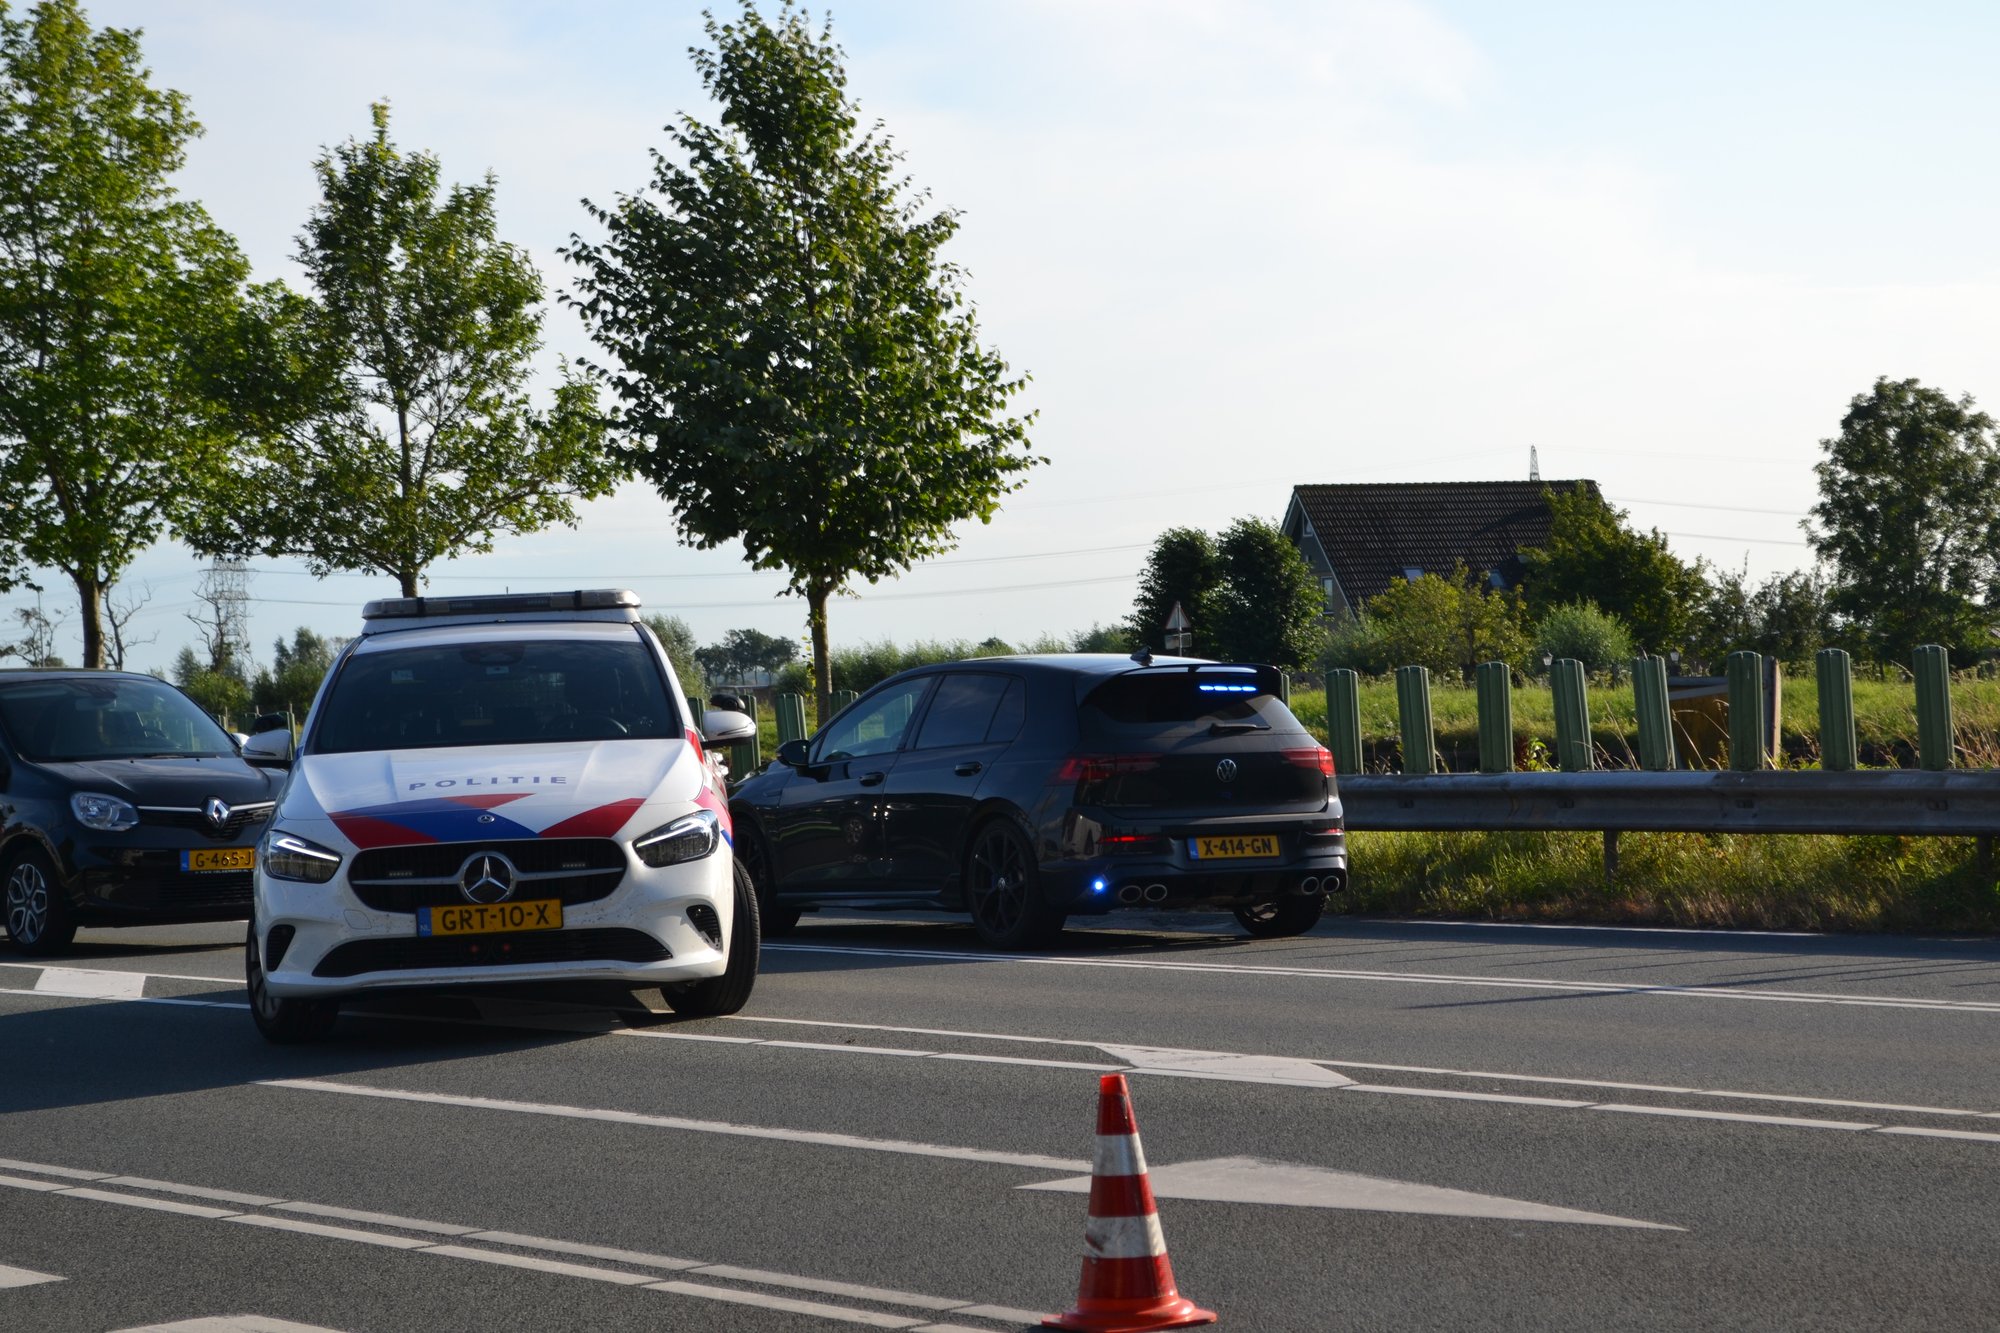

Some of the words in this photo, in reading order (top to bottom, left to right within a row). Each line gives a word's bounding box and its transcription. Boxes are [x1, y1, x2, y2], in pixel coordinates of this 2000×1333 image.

[408, 776, 567, 791] POLITIE
[1203, 838, 1273, 856] X-414-GN
[195, 850, 252, 868] G-465-J
[442, 904, 549, 931] GRT-10-X
[420, 924, 431, 932] NL
